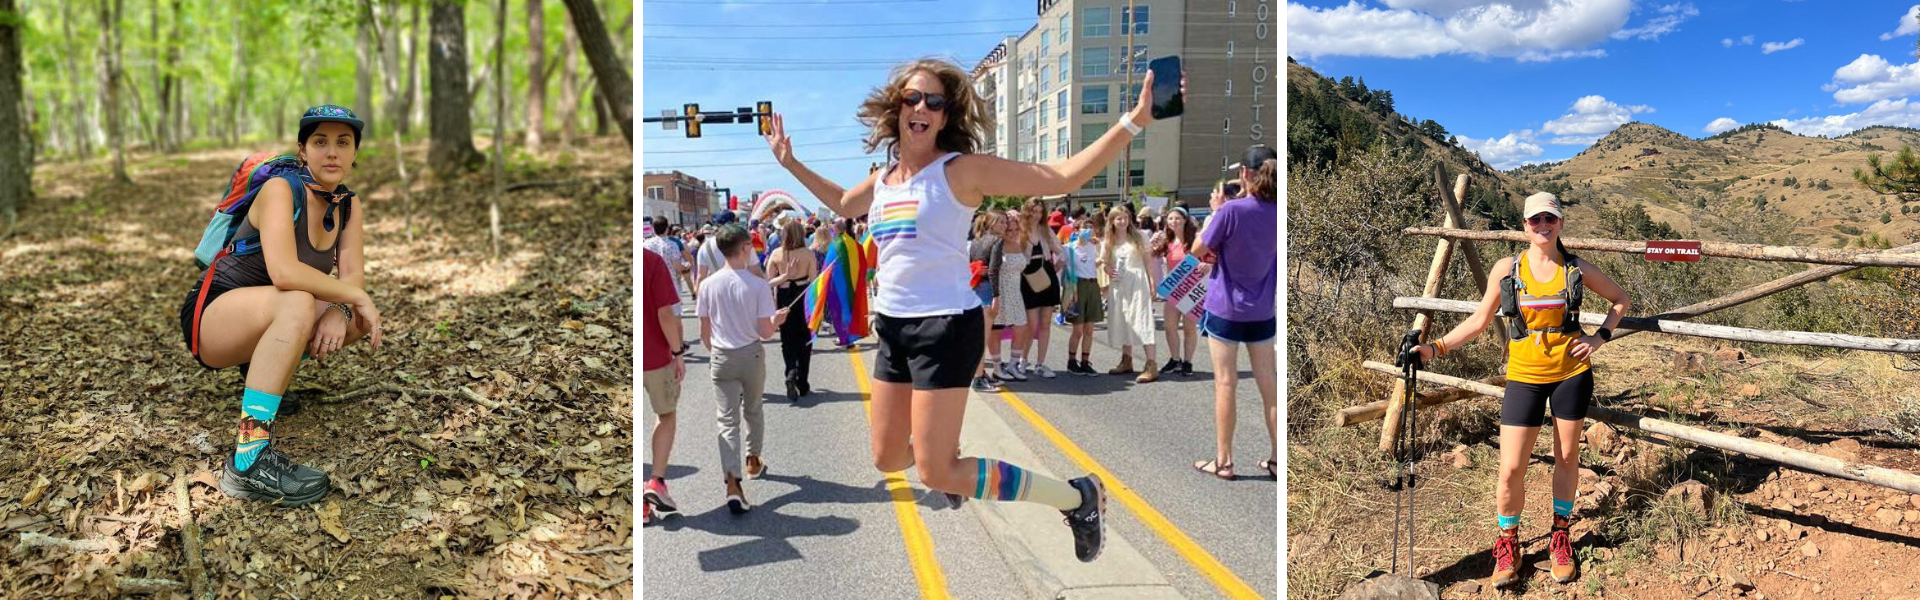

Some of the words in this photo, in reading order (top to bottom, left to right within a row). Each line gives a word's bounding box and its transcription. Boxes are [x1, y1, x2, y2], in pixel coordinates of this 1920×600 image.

[1256, 0, 1269, 40] 00
[1250, 46, 1267, 141] LOFTS
[1161, 260, 1192, 291] TRANS
[1170, 268, 1204, 301] RIGHTS
[1188, 282, 1208, 303] ARE
